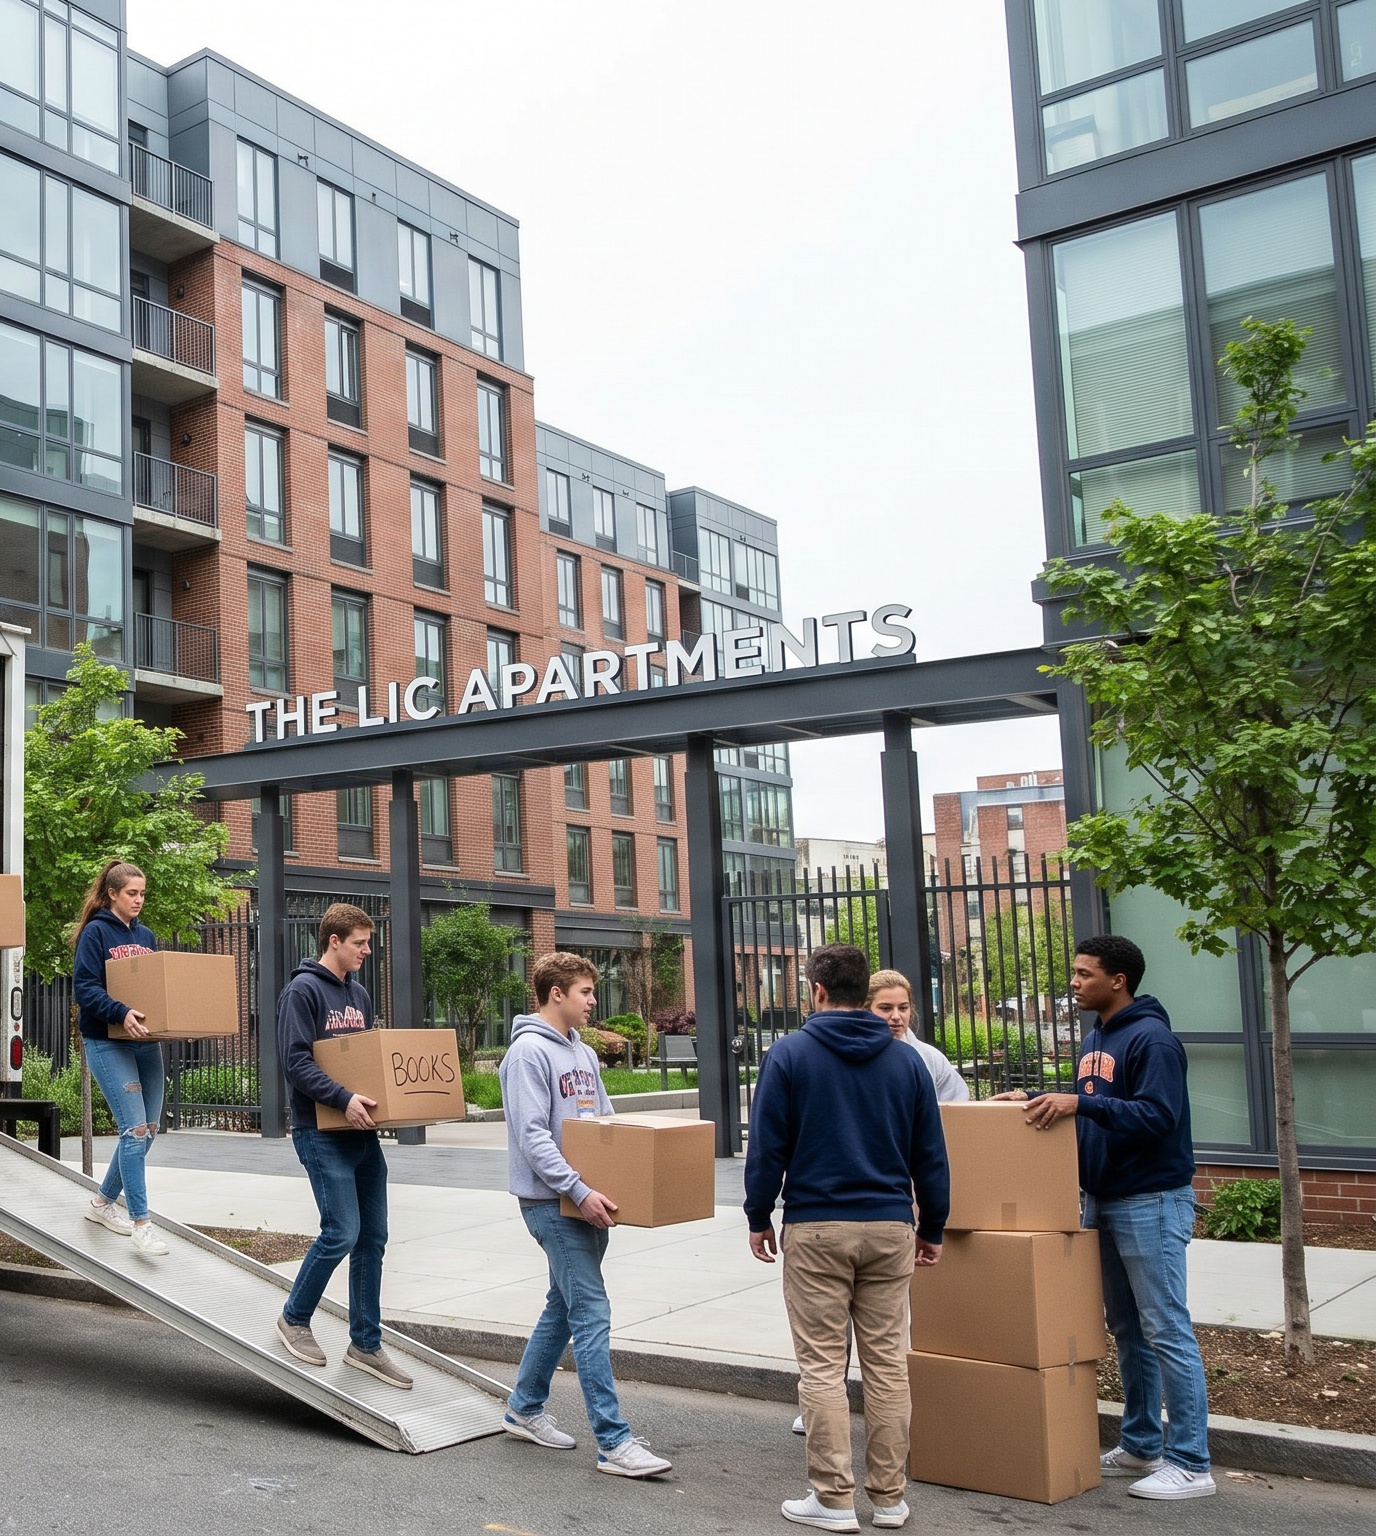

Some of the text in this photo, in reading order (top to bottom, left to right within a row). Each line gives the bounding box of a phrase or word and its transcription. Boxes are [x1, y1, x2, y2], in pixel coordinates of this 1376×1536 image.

[245, 604, 916, 743] THE LIC APARTMENTS
[391, 1052, 456, 1087] BOOKS
